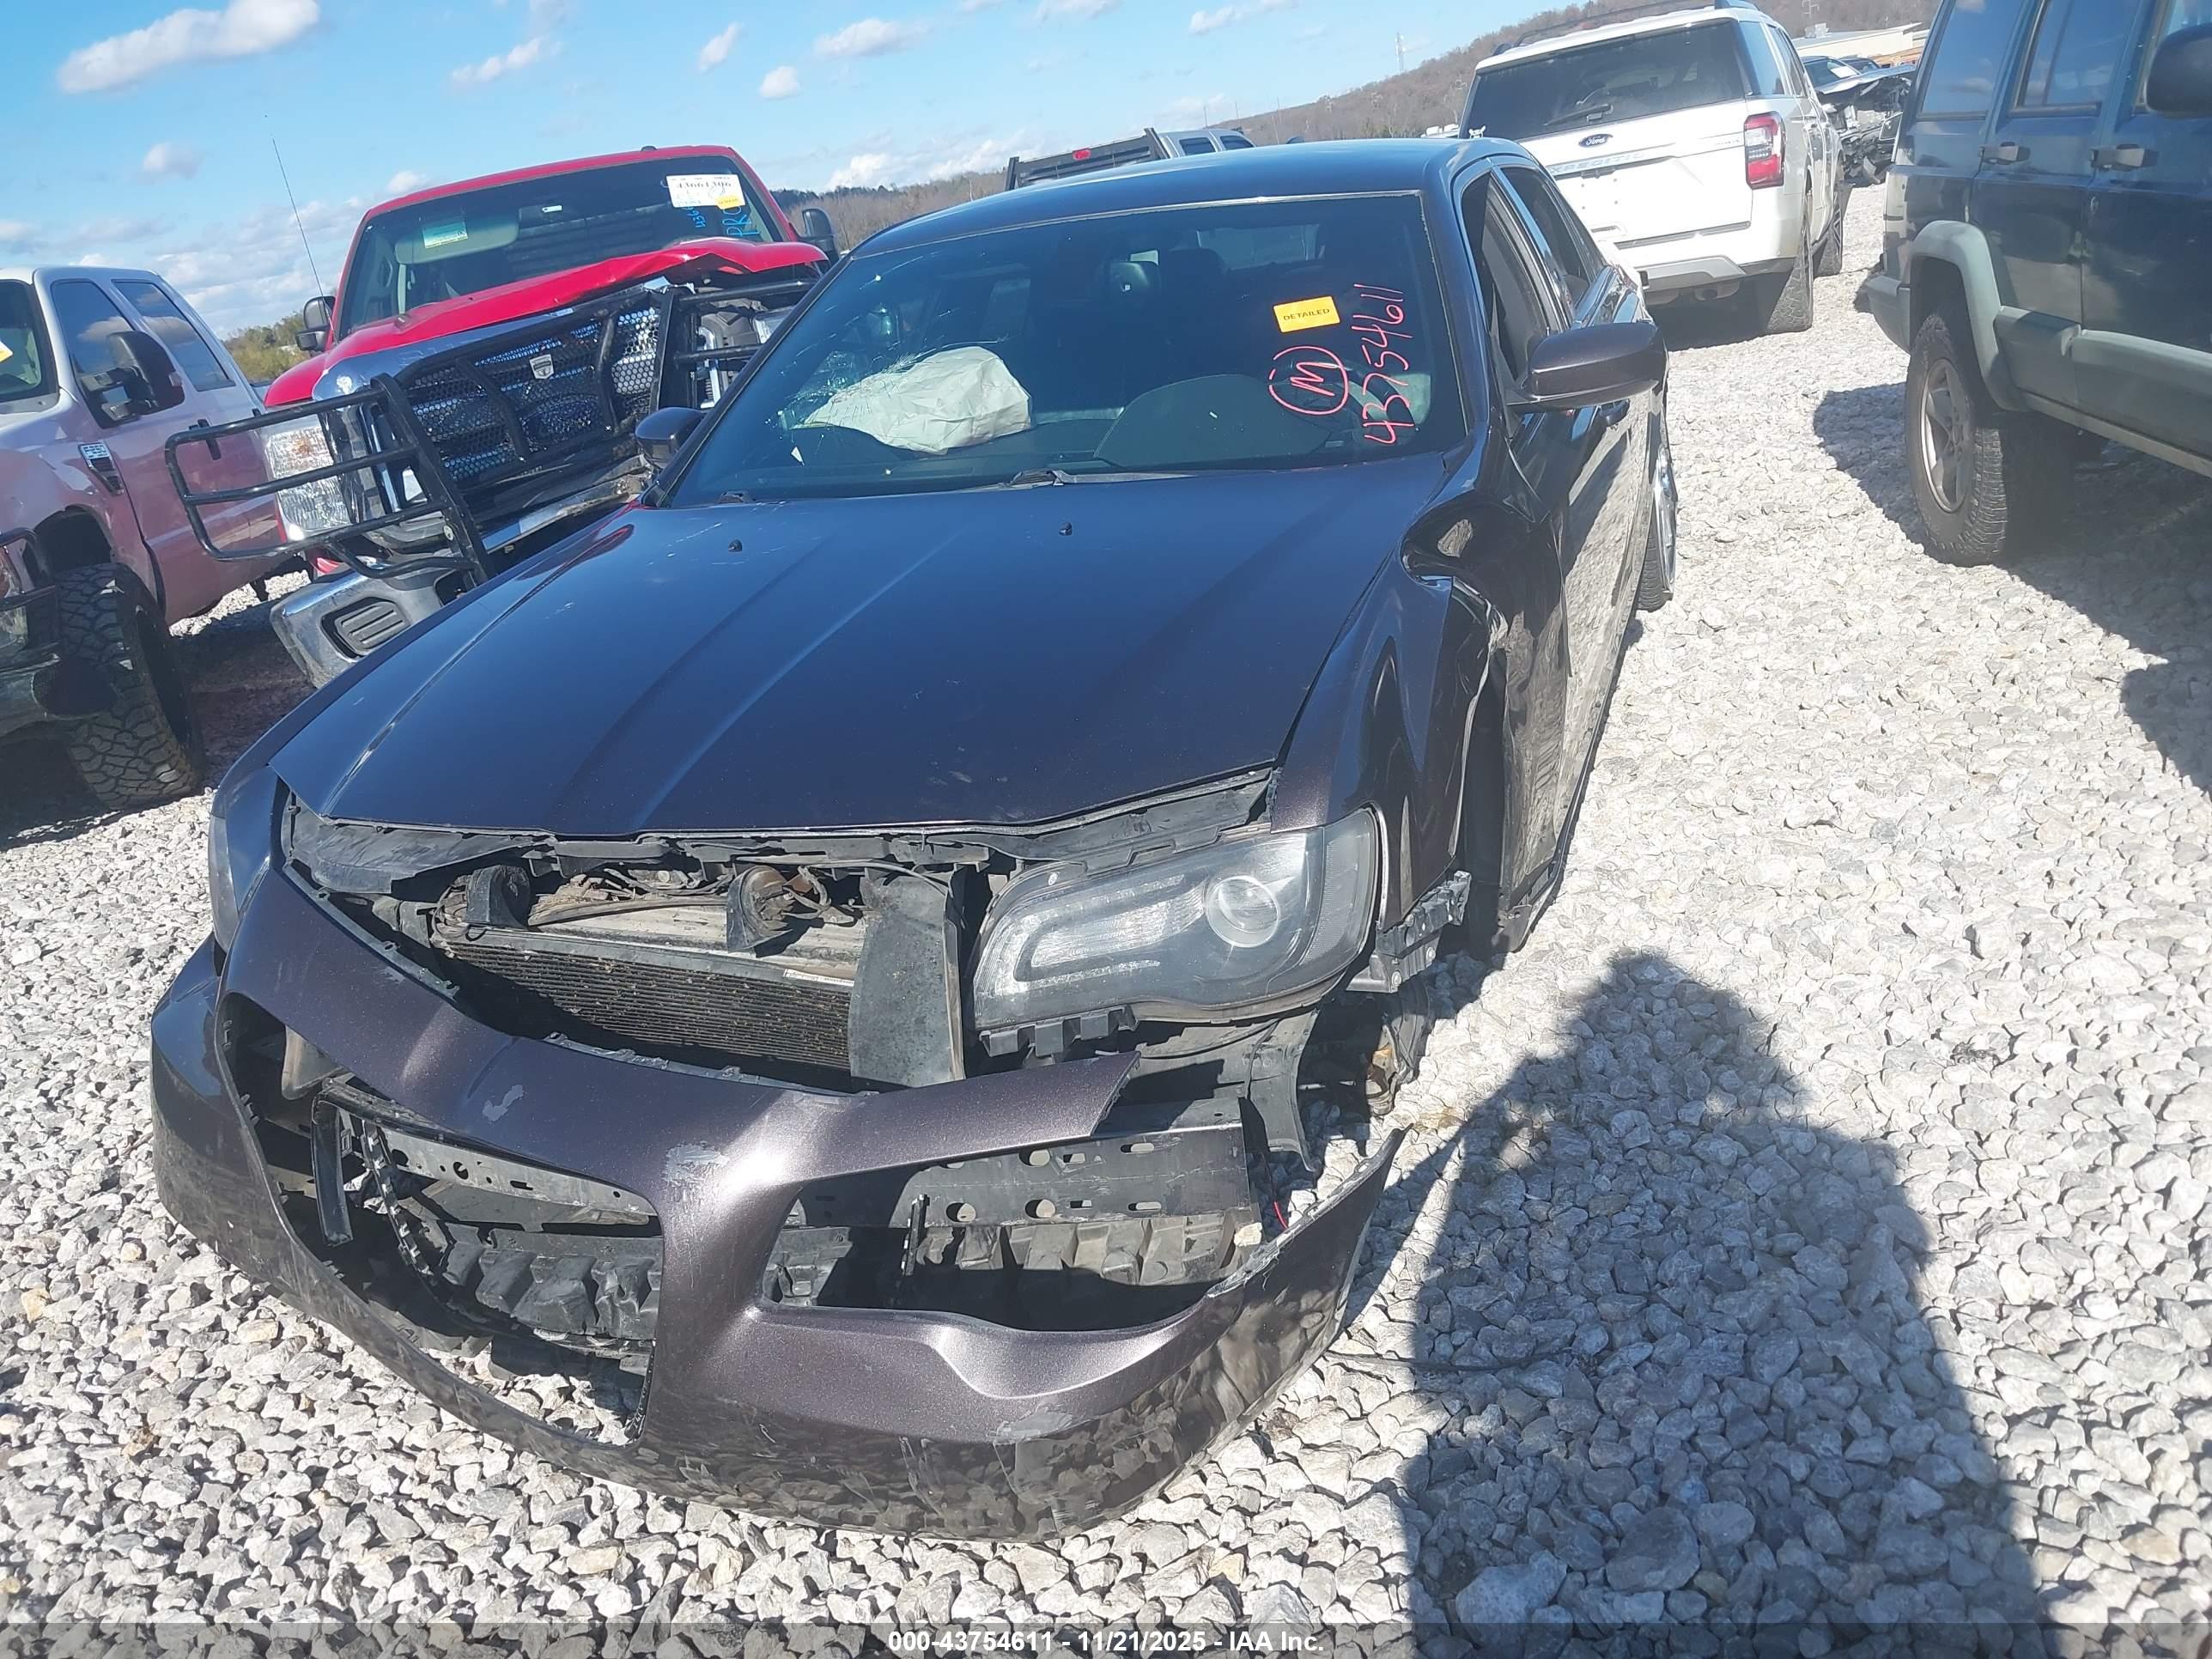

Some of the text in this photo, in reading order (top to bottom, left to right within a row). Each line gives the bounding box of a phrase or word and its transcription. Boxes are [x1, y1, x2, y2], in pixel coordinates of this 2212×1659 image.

[1583, 135, 1607, 146] Ford
[1283, 307, 1330, 321] DETAILED
[1351, 283, 1414, 444] 43754611
